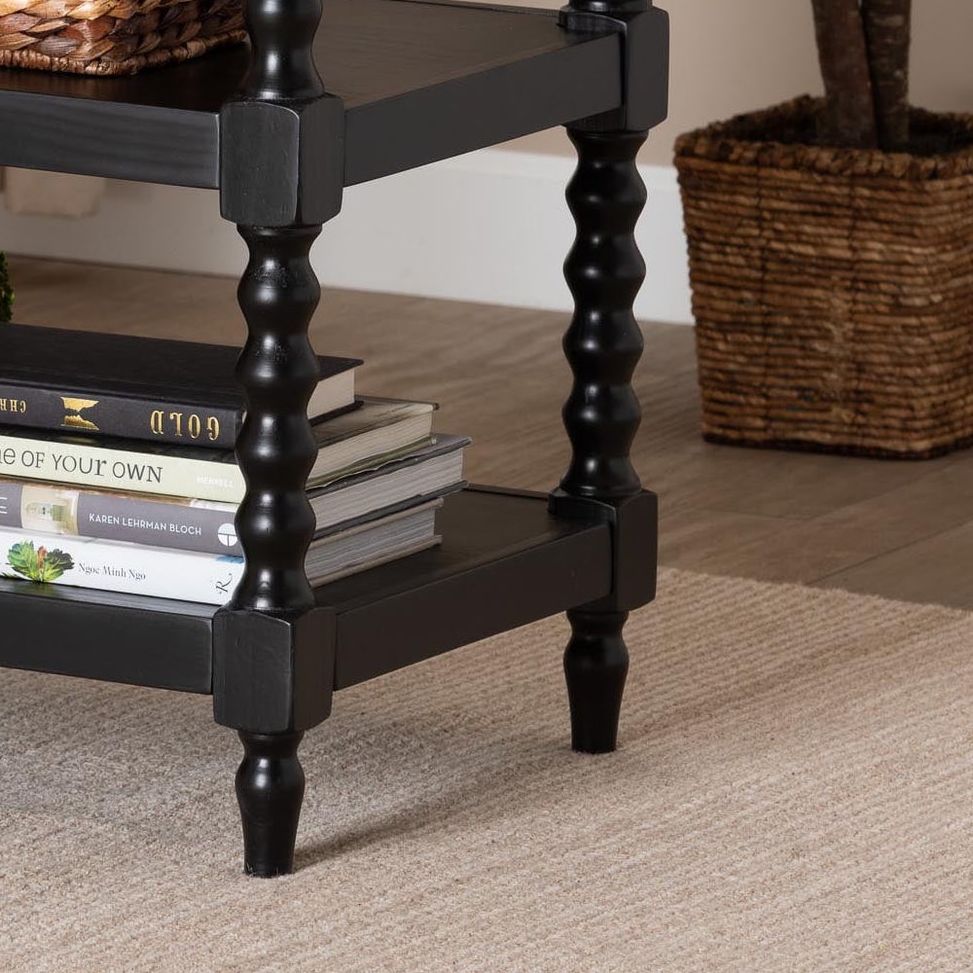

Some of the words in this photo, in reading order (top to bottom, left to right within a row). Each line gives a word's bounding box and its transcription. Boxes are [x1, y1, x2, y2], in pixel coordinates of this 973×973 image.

[150, 410, 220, 441] GOLD
[21, 450, 46, 468] OF
[112, 462, 163, 483] OWN
[89, 513, 120, 525] KAREN
[122, 518, 167, 531] LEHRMAN
[169, 523, 202, 535] BLOCH
[102, 565, 127, 578] Minh
[129, 569, 146, 580] Ngo
